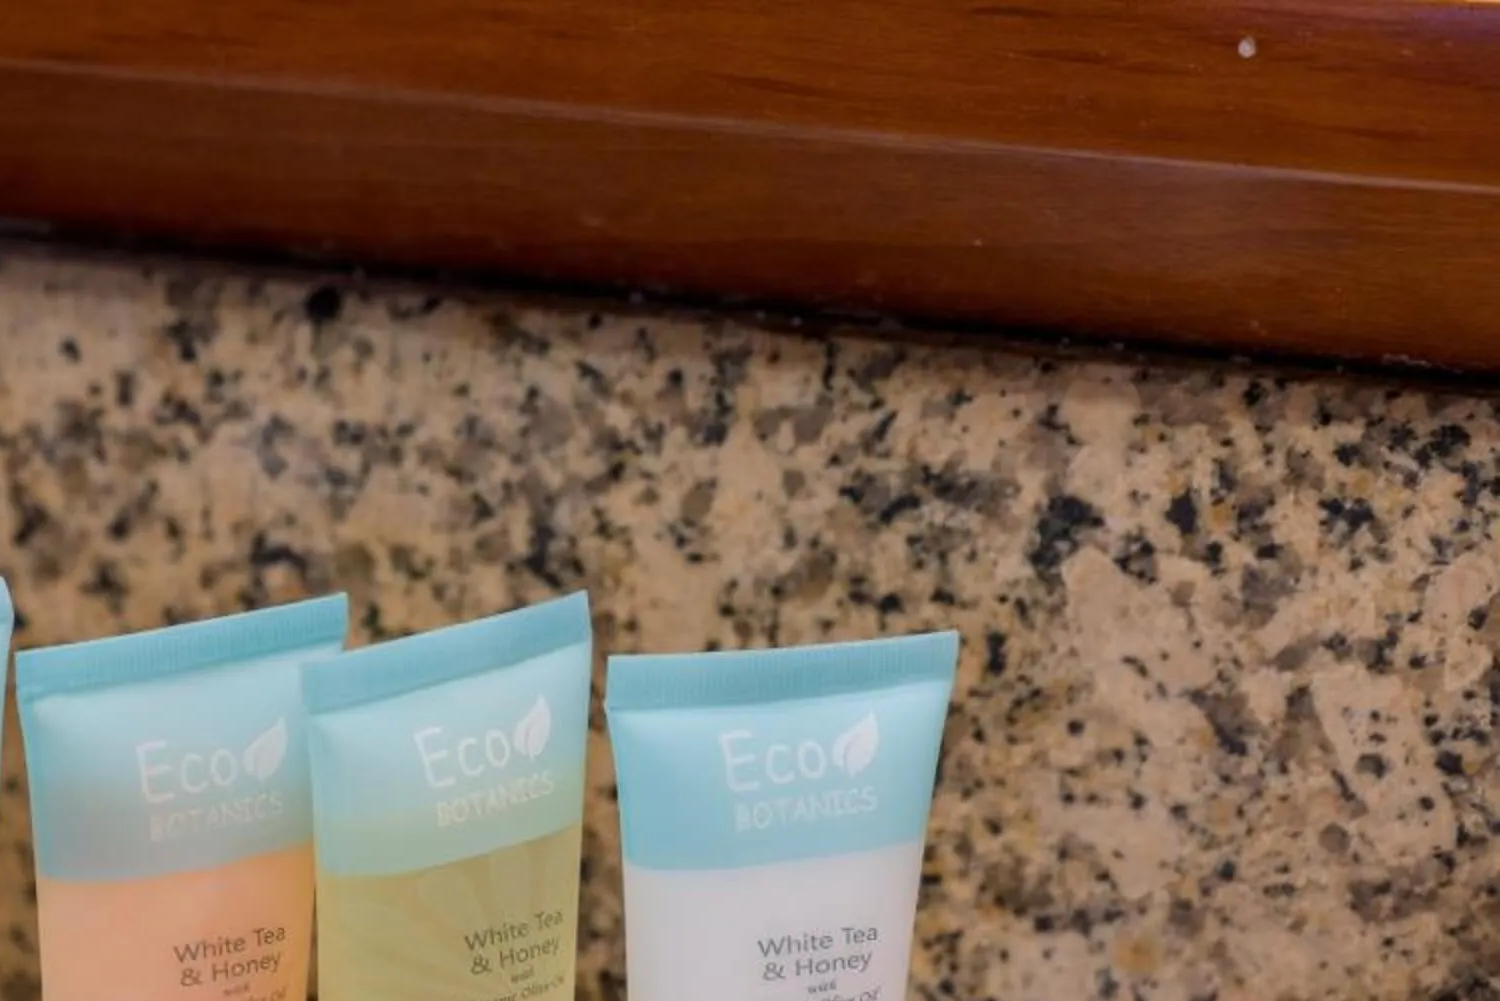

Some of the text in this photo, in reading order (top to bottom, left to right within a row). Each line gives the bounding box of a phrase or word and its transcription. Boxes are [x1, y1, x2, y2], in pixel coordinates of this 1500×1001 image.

[150, 790, 284, 842] BOTANICS
[436, 771, 555, 828] BOTANICS
[735, 785, 879, 832] BOTANICS
[173, 927, 286, 963] White Tea
[464, 910, 563, 952] White Tea
[757, 926, 879, 958] White Tea
[180, 951, 282, 987] & Honey
[470, 936, 561, 976] & Honey
[762, 951, 873, 982] & Honey
